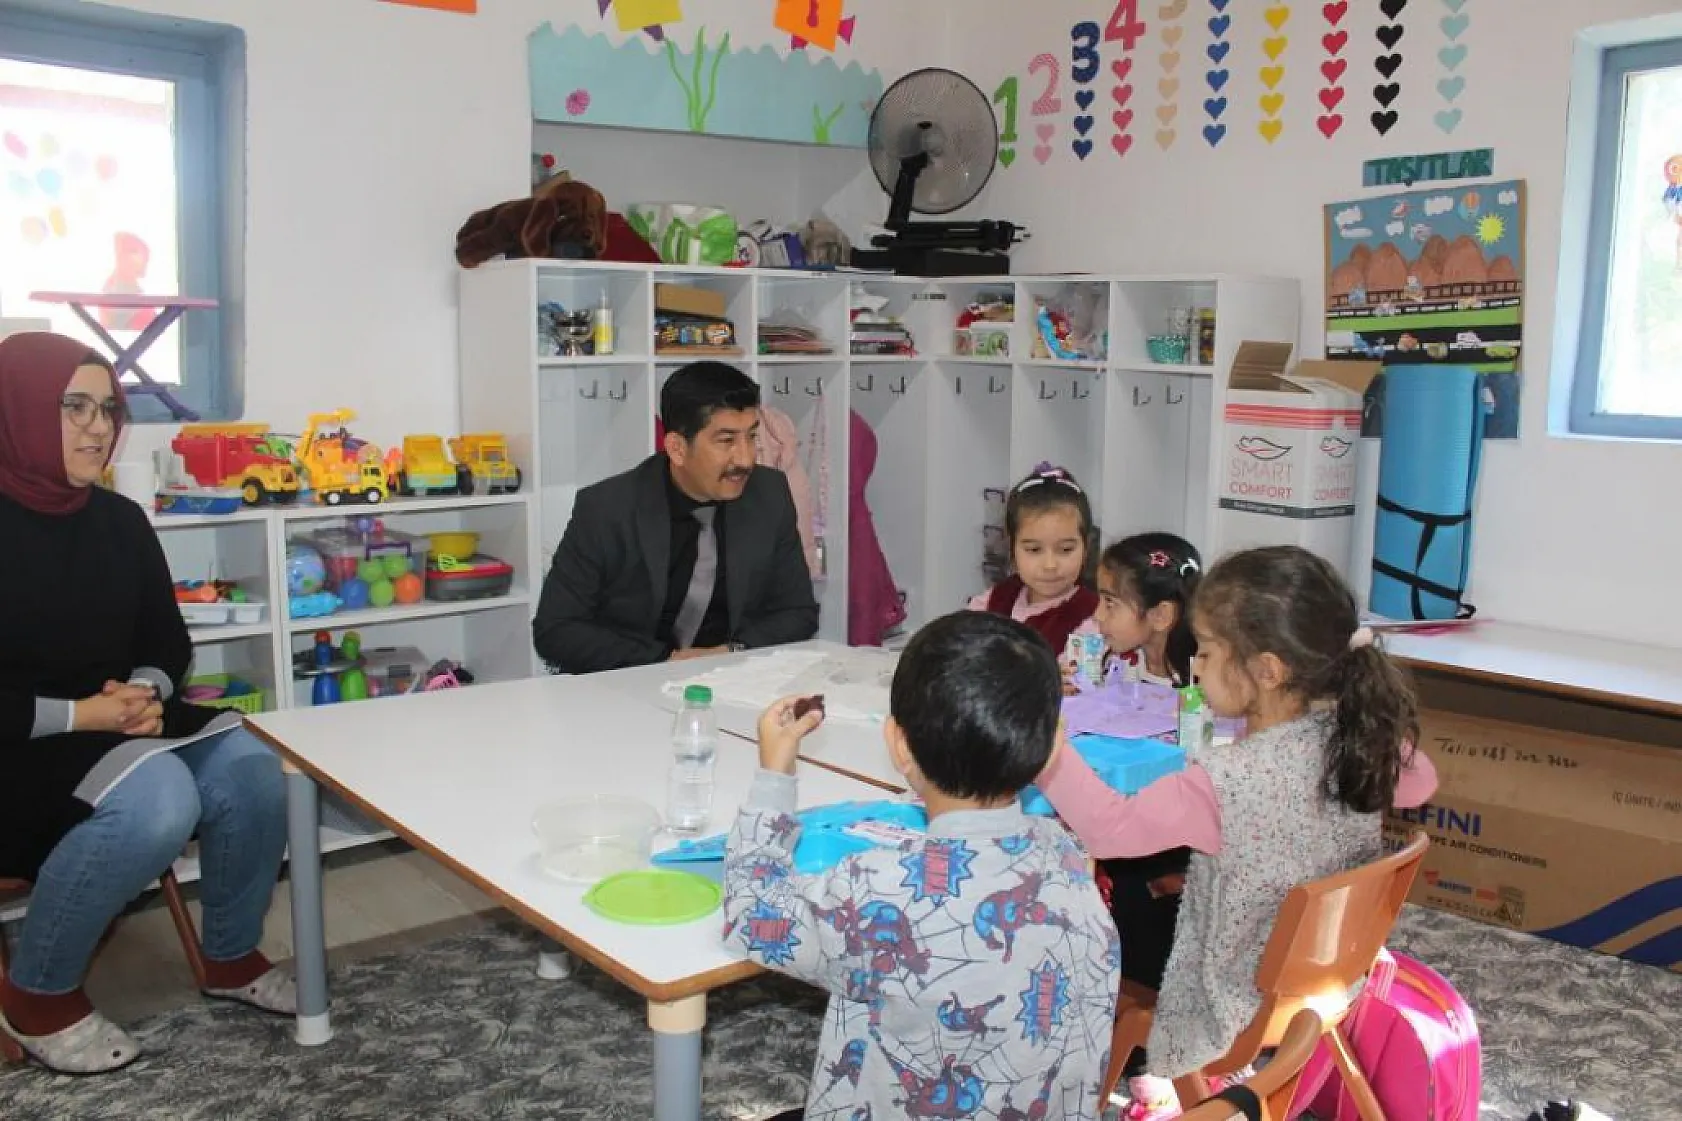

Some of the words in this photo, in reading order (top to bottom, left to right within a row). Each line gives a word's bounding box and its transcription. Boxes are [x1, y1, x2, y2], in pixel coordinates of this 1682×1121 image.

[994, 77, 1017, 142] 1
[1028, 53, 1061, 116] 2
[1071, 21, 1100, 83] 3
[1105, 0, 1145, 51] 4
[1231, 457, 1293, 482] SMART
[1229, 481, 1293, 500] COMFORT
